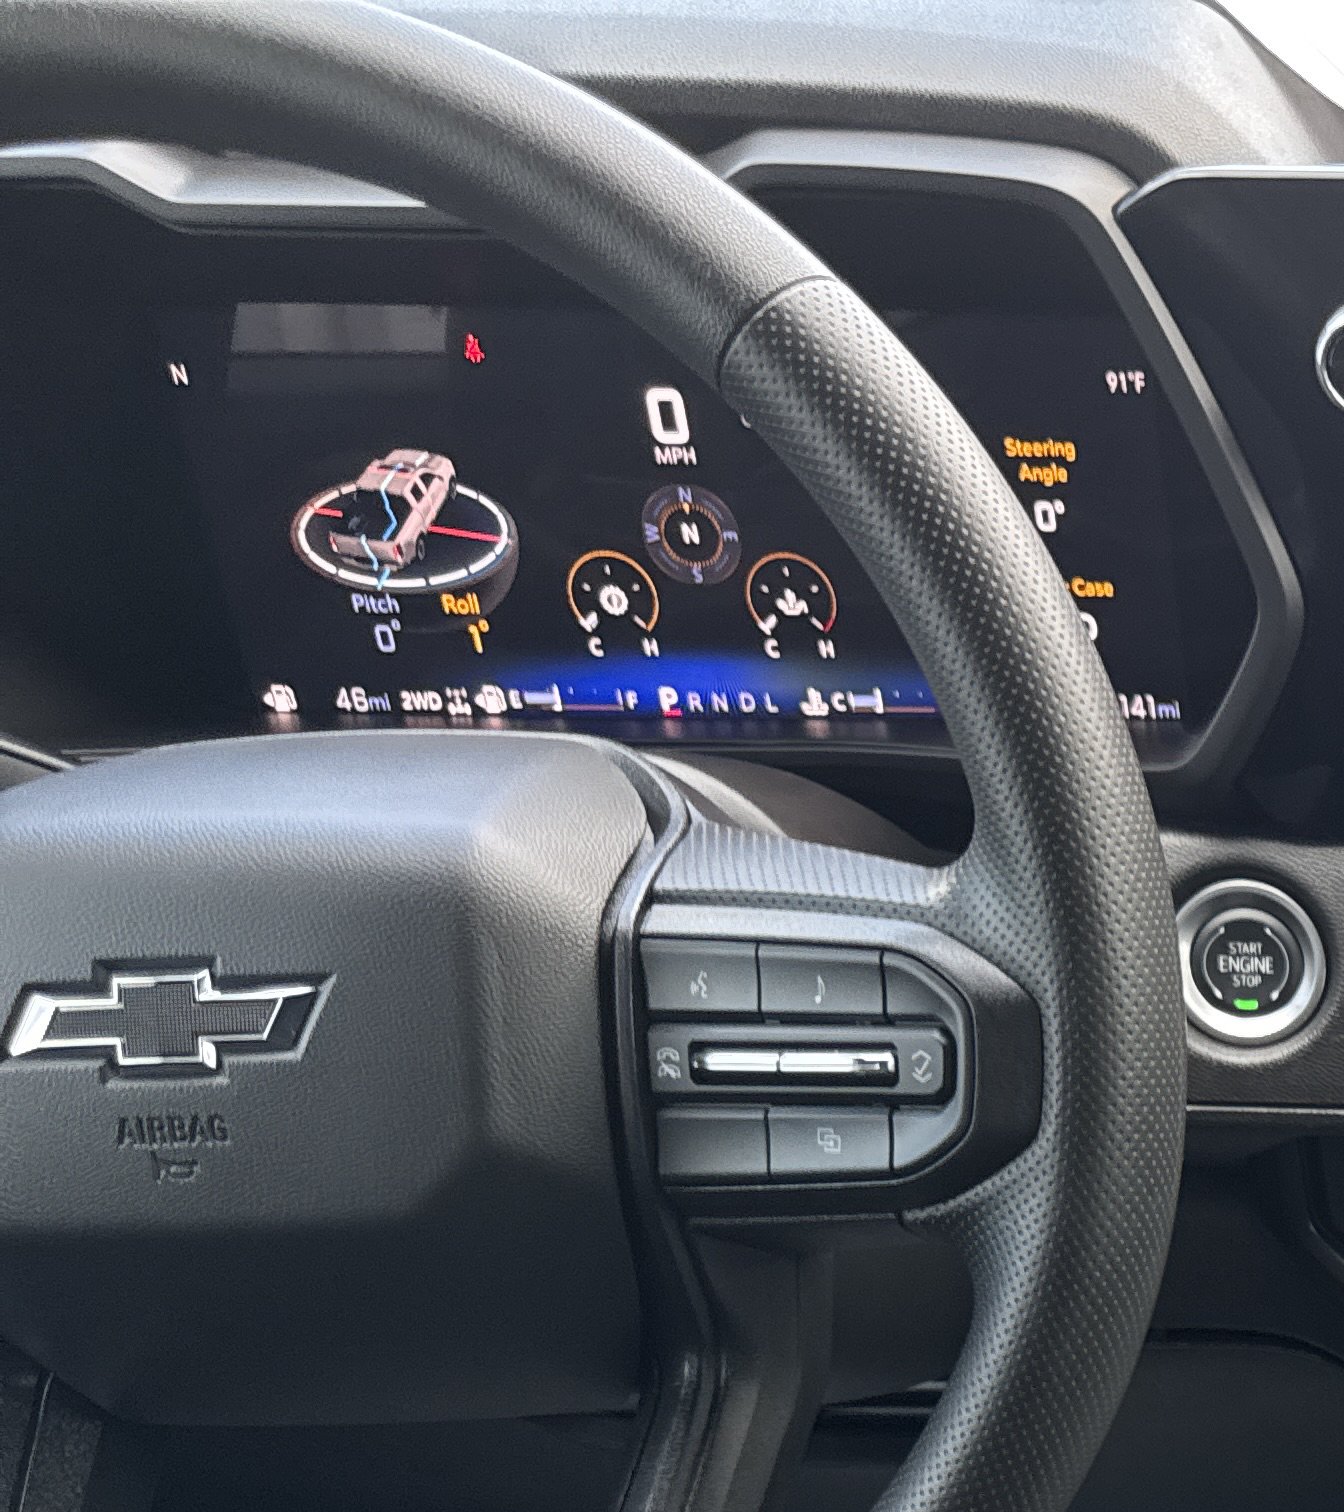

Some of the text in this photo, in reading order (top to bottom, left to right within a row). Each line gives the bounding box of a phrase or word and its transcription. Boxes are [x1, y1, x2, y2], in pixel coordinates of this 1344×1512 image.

[169, 362, 188, 385] N
[1105, 370, 1145, 394] 91°F
[646, 386, 690, 445] 0
[654, 445, 697, 466] MPH
[1003, 436, 1076, 462] Steering
[1018, 462, 1068, 487] Angle
[1034, 499, 1065, 532] 0°
[680, 521, 700, 545] N
[351, 593, 399, 615] Pitch
[441, 593, 480, 615] Roll
[400, 689, 443, 711] 2WD
[658, 686, 679, 711] P
[1228, 942, 1262, 955] START
[1218, 955, 1274, 974] ENGINE
[1232, 975, 1262, 988] STOP
[116, 1115, 228, 1146] AIRBAG
